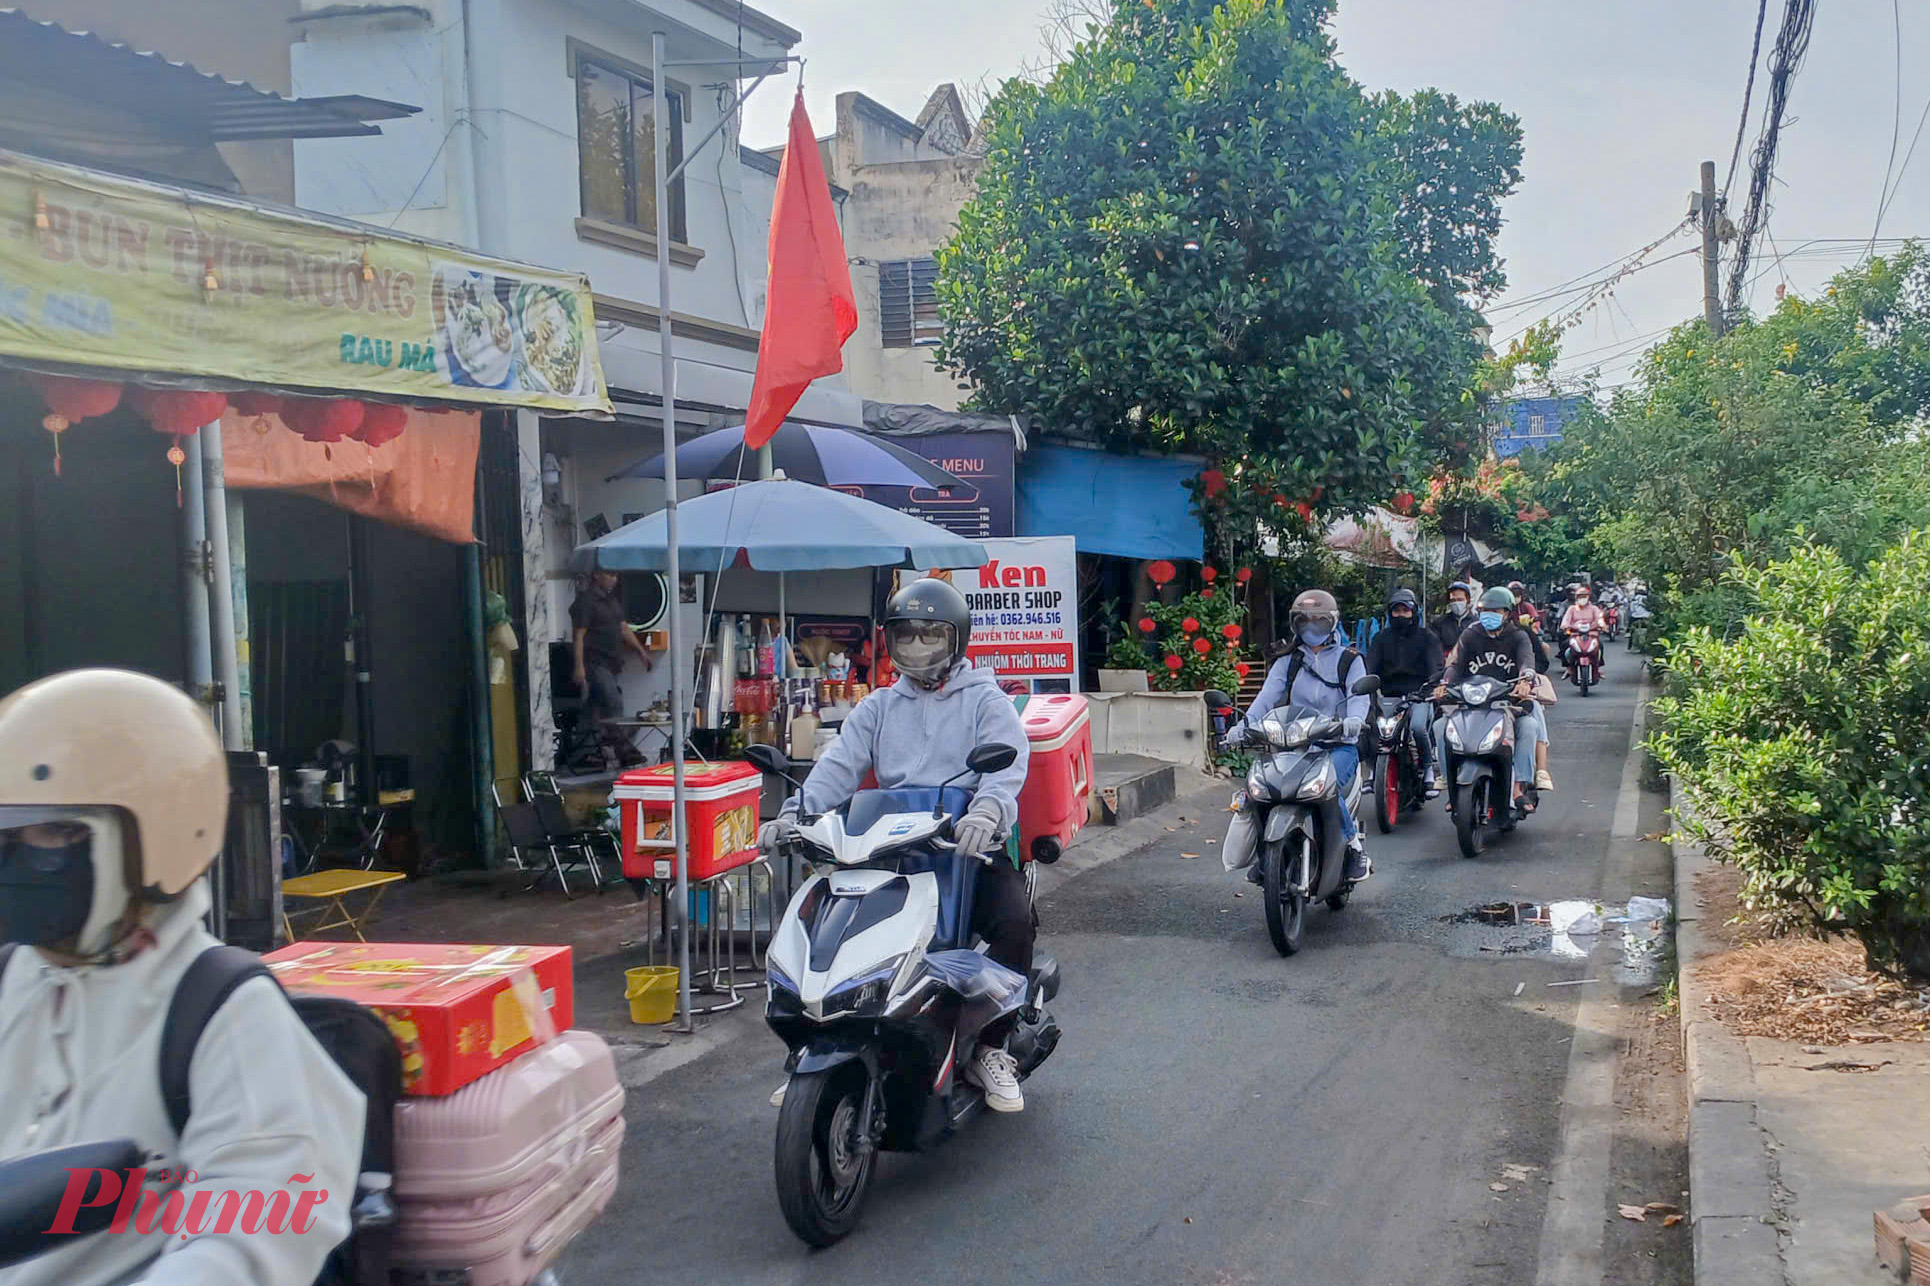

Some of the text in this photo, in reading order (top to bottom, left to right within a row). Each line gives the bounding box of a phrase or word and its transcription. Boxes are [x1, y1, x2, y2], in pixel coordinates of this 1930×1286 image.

[340, 333, 437, 372] RAU MÁ
[942, 458, 984, 472] MENU
[979, 559, 1047, 588] Ken
[965, 591, 1062, 610] BARBER SHOP
[1000, 611, 1061, 625] 0362.946.516
[1003, 628, 1020, 641] TÓC
[1022, 630, 1043, 641] NAM
[1051, 628, 1064, 641] NỮ
[975, 651, 1067, 673] NHUỘM THỜI TRANG
